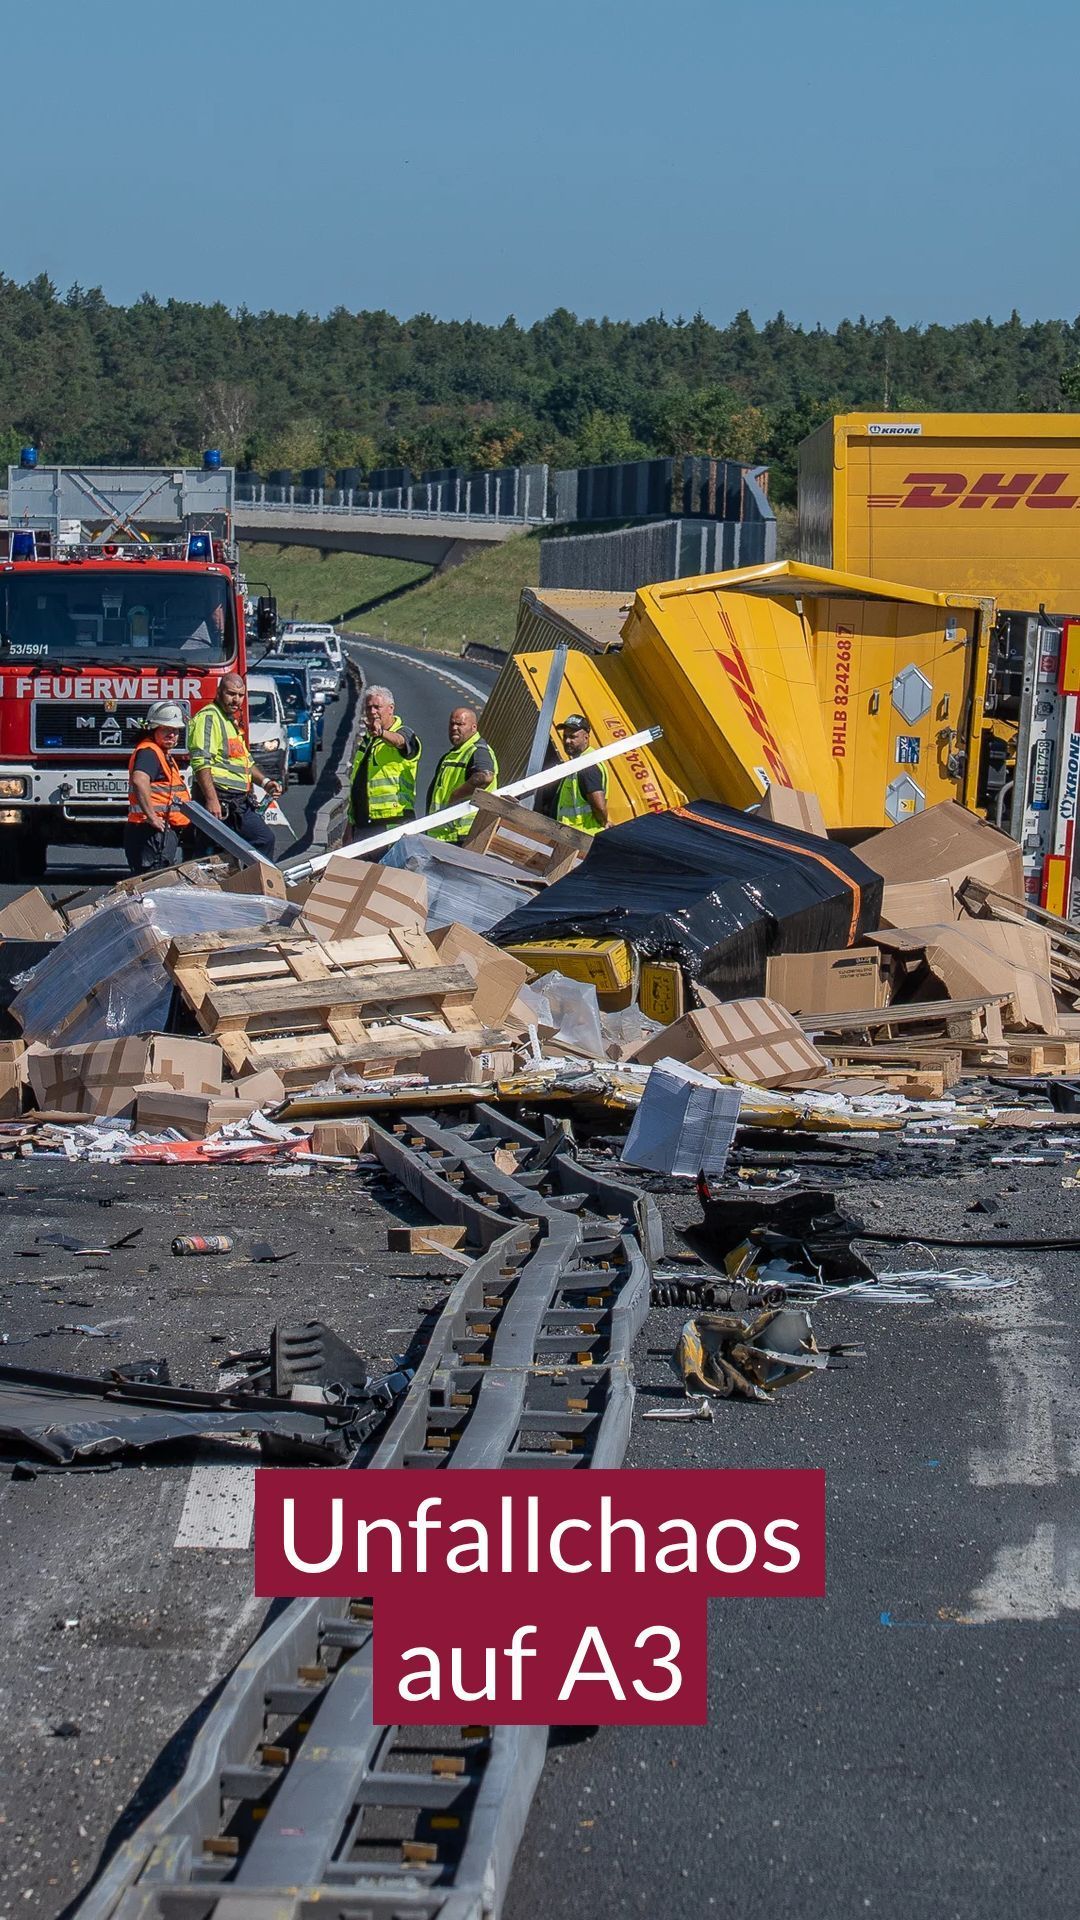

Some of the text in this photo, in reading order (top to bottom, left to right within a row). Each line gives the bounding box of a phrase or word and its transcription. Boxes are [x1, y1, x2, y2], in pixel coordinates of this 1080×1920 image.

[899, 472, 1080, 509] DHL
[9, 644, 49, 655] 53/59/1
[16, 677, 202, 699] FEUERWEHR
[76, 716, 142, 729] MAN
[832, 710, 848, 758] DHLB
[1065, 733, 1080, 799] KRONE
[642, 782, 664, 814] HLB
